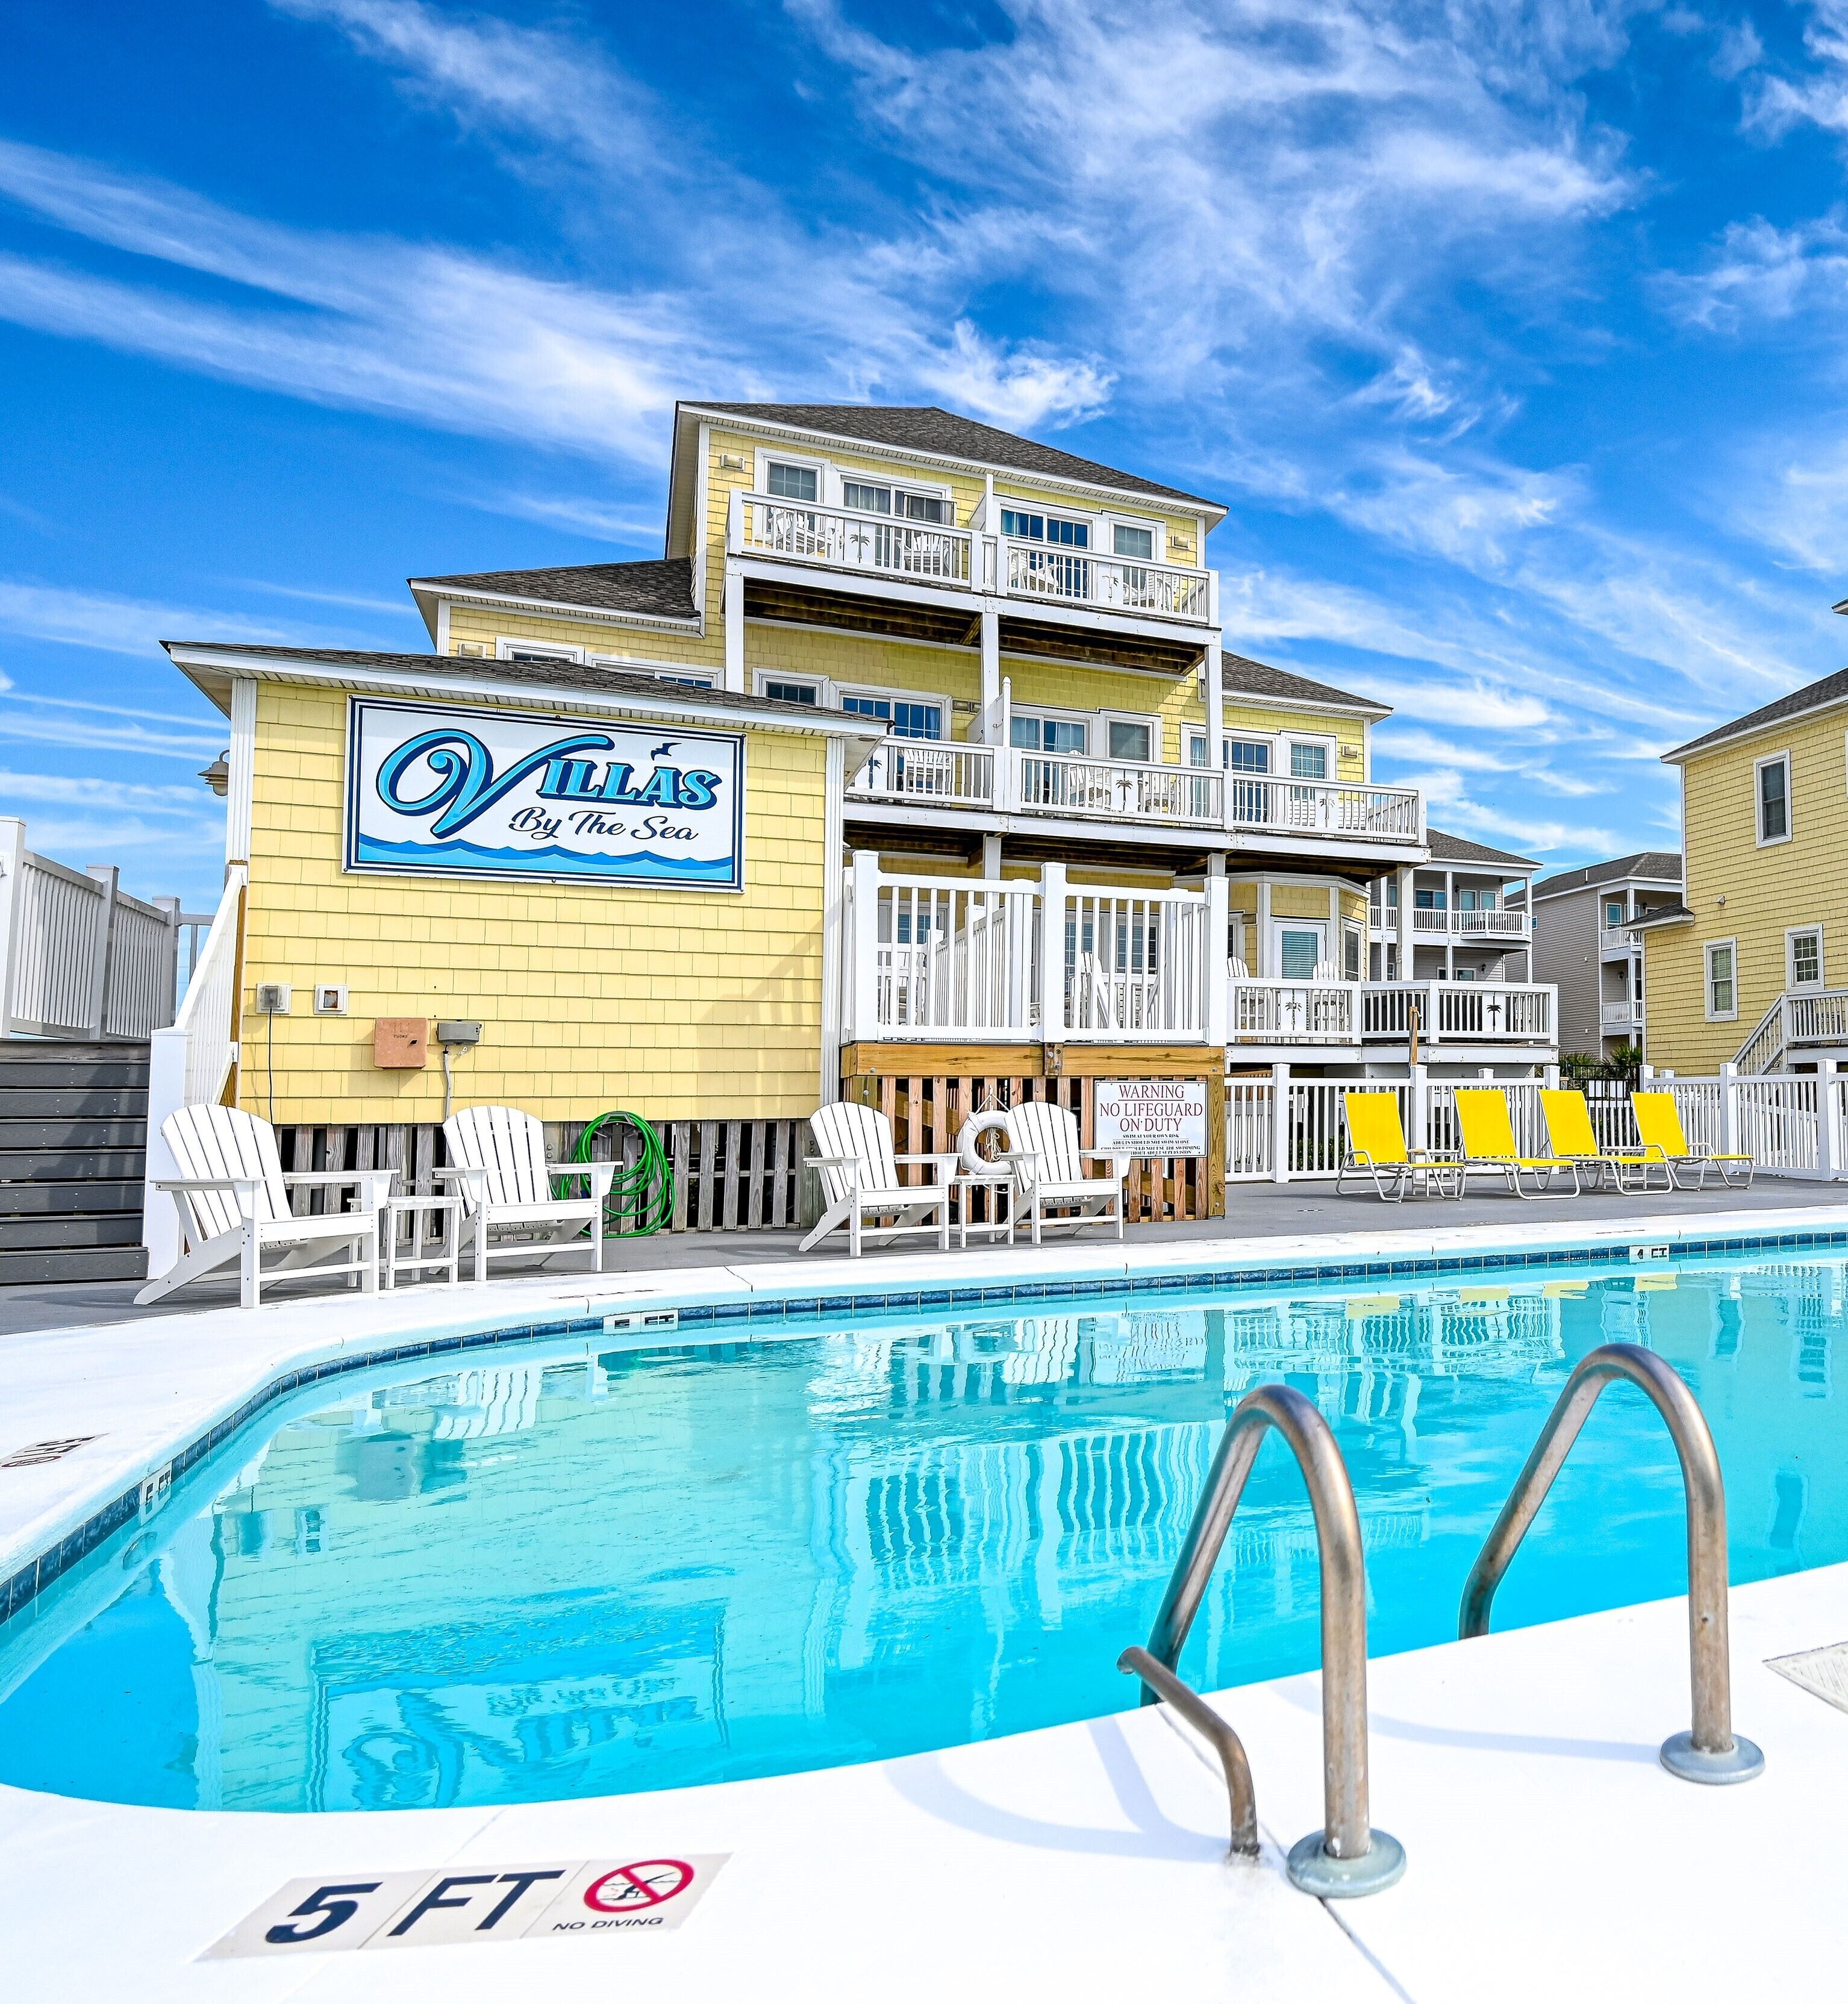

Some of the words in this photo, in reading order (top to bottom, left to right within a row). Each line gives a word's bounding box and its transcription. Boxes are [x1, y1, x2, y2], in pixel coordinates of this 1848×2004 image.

[376, 728, 722, 840] VILLAS
[508, 807, 563, 840] By
[568, 810, 626, 836] The
[630, 816, 699, 840] Sea
[1119, 1085, 1184, 1099] WARNING
[1100, 1103, 1120, 1116] NO
[1125, 1103, 1203, 1116] LIFEGUARD
[1120, 1118, 1140, 1132] ON
[1144, 1118, 1182, 1131] DUTY
[264, 1882, 384, 1944] 5
[387, 1869, 566, 1937] FT
[552, 1921, 587, 1931] NO
[592, 1917, 664, 1929] DIVING
